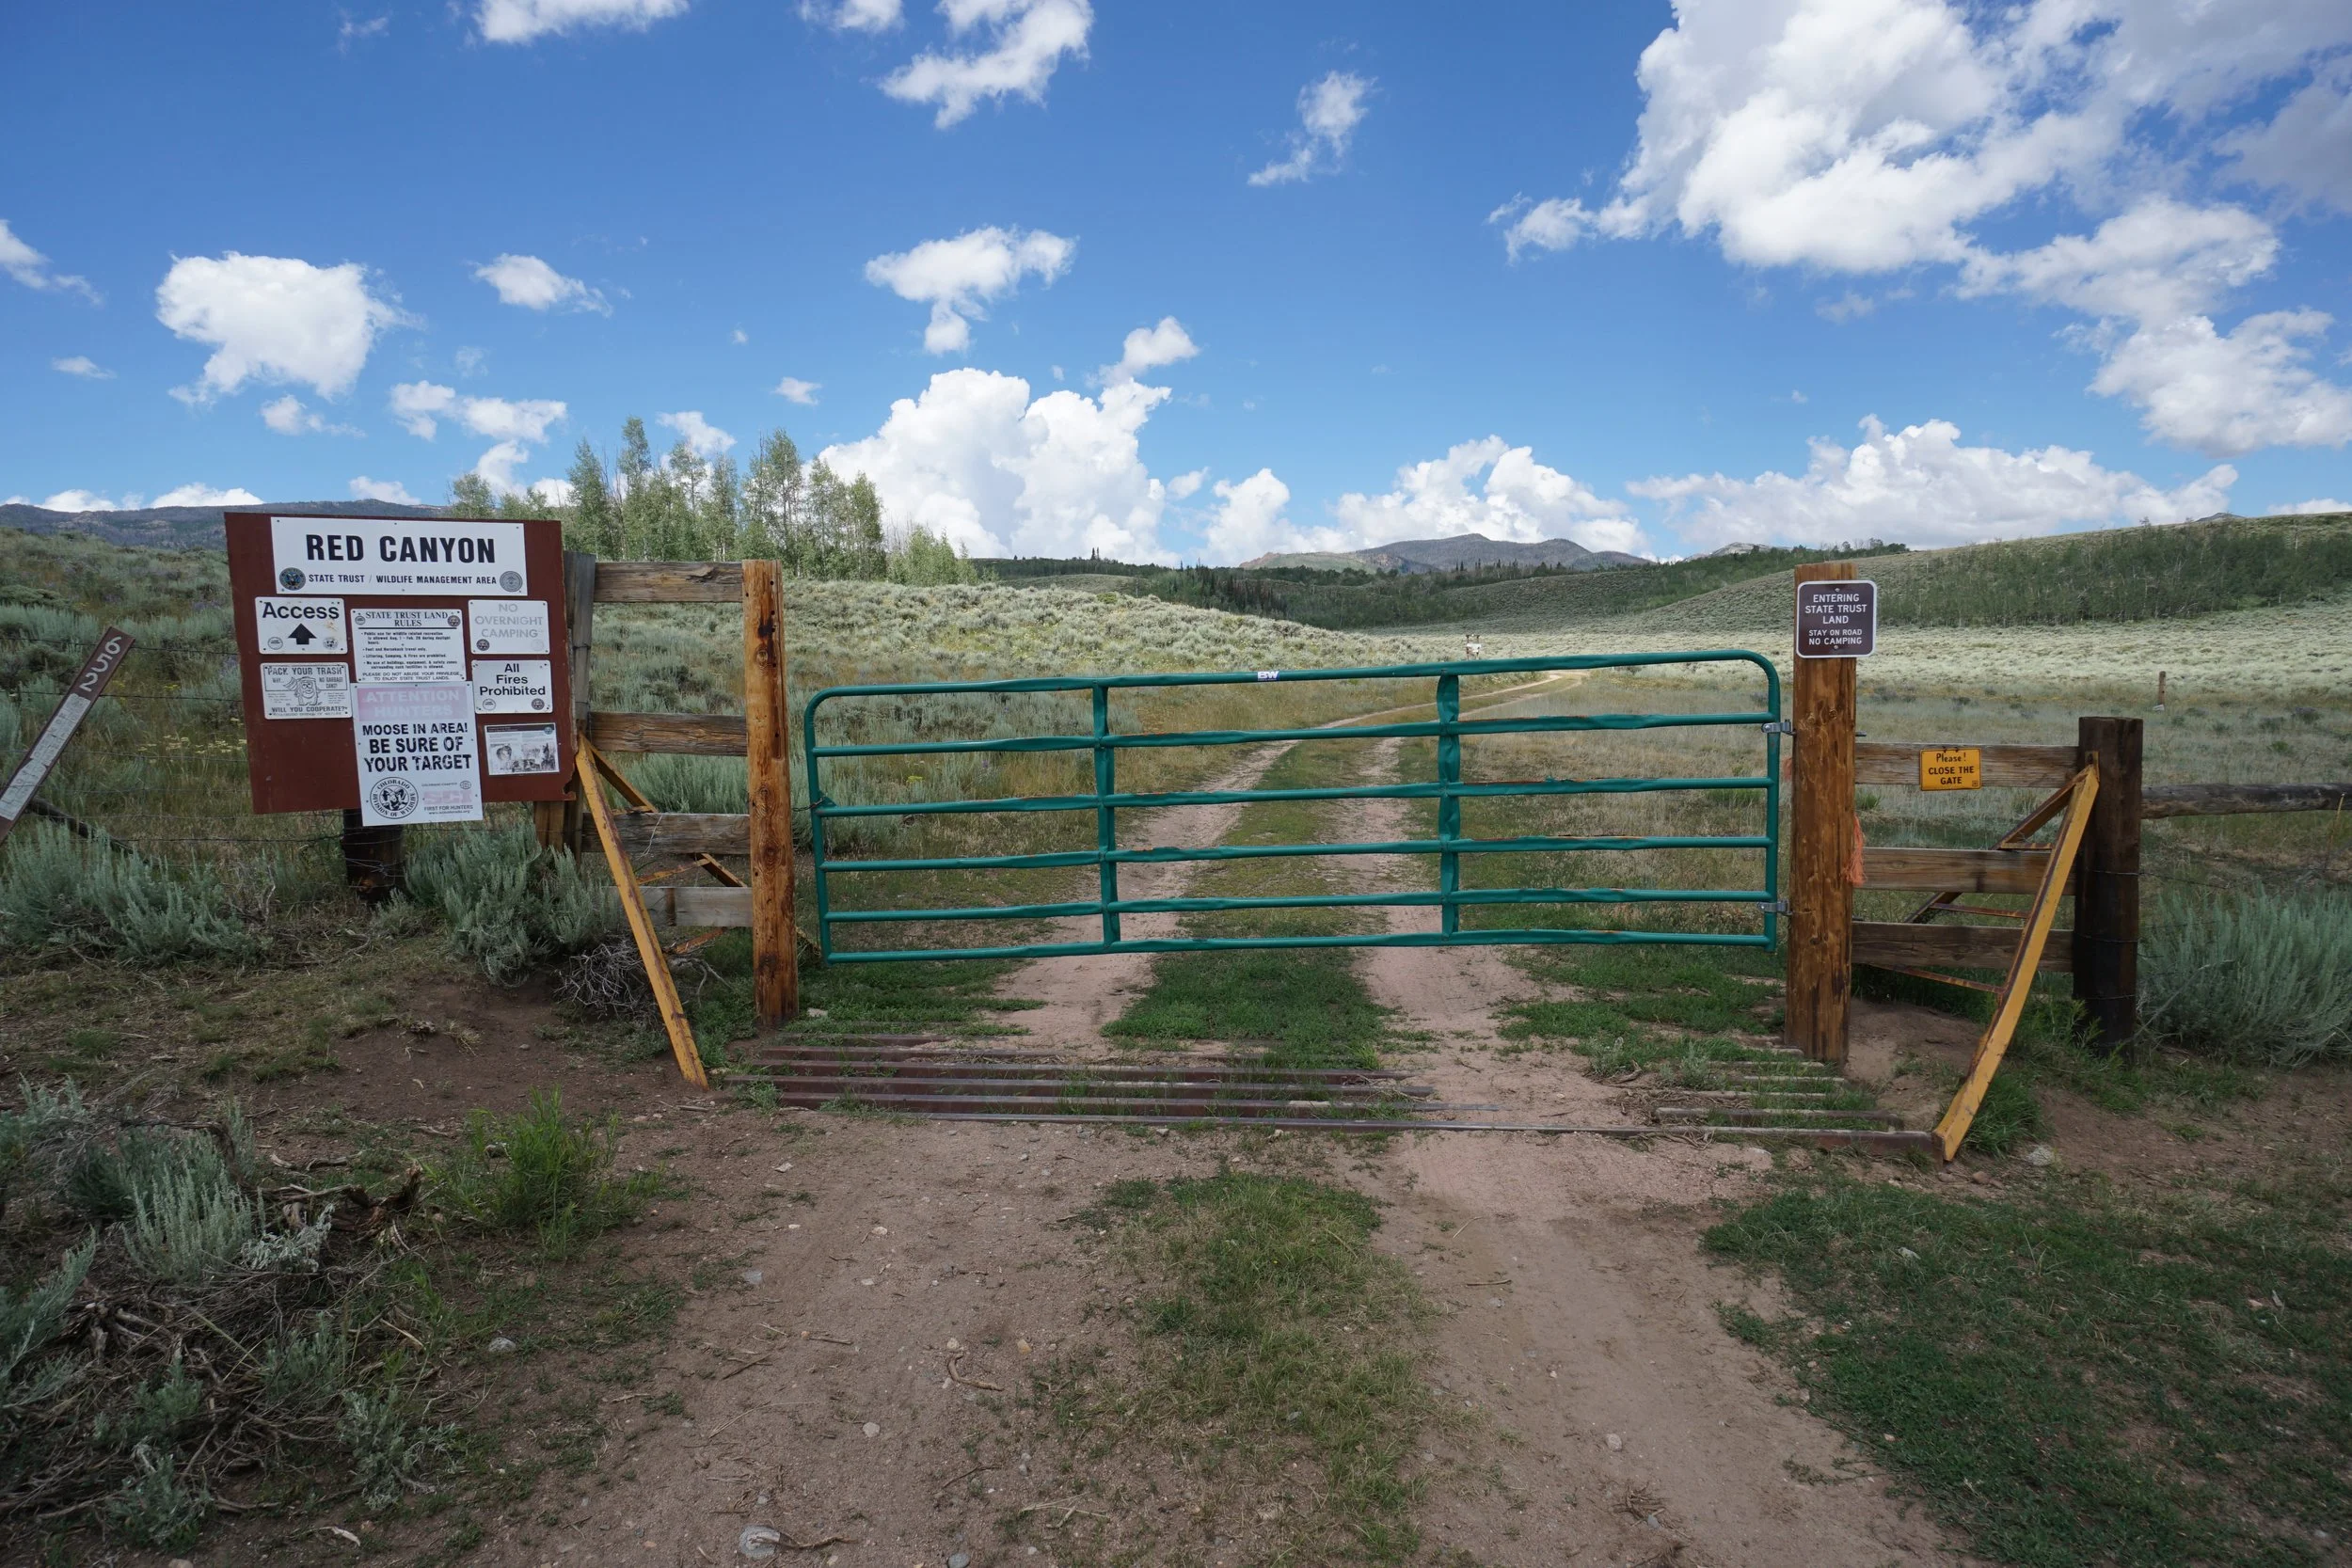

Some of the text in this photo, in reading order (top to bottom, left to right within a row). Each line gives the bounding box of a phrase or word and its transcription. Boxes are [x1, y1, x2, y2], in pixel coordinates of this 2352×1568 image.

[306, 534, 496, 563] RED CANYON
[309, 574, 334, 583] STATE
[338, 575, 365, 583] TRUST
[376, 575, 413, 584] WILDLIFE
[416, 576, 472, 584] MANAGEMENT
[476, 576, 497, 584] AREA
[1813, 594, 1860, 602] ENTERING
[262, 602, 339, 619] Access
[499, 603, 518, 612] NO
[1805, 604, 1867, 614] STATE TRUST
[475, 616, 543, 626] OVERNIGHT
[1823, 616, 1849, 624] LAND
[481, 629, 538, 638] CAMPING
[317, 667, 342, 675] TRASH
[504, 663, 520, 673] All
[496, 674, 528, 684] Fires
[364, 689, 460, 703] ATTENTION
[479, 686, 546, 696] Prohibited
[374, 704, 453, 717] HUNTERS
[362, 722, 468, 735] MOOSE IN AREA!
[369, 736, 463, 754] BE SURE OF
[364, 754, 472, 772] YOUR TARGET
[1928, 767, 1955, 775] CLOSE
[377, 779, 410, 789] COLORADO
[1940, 777, 1963, 785] GATE
